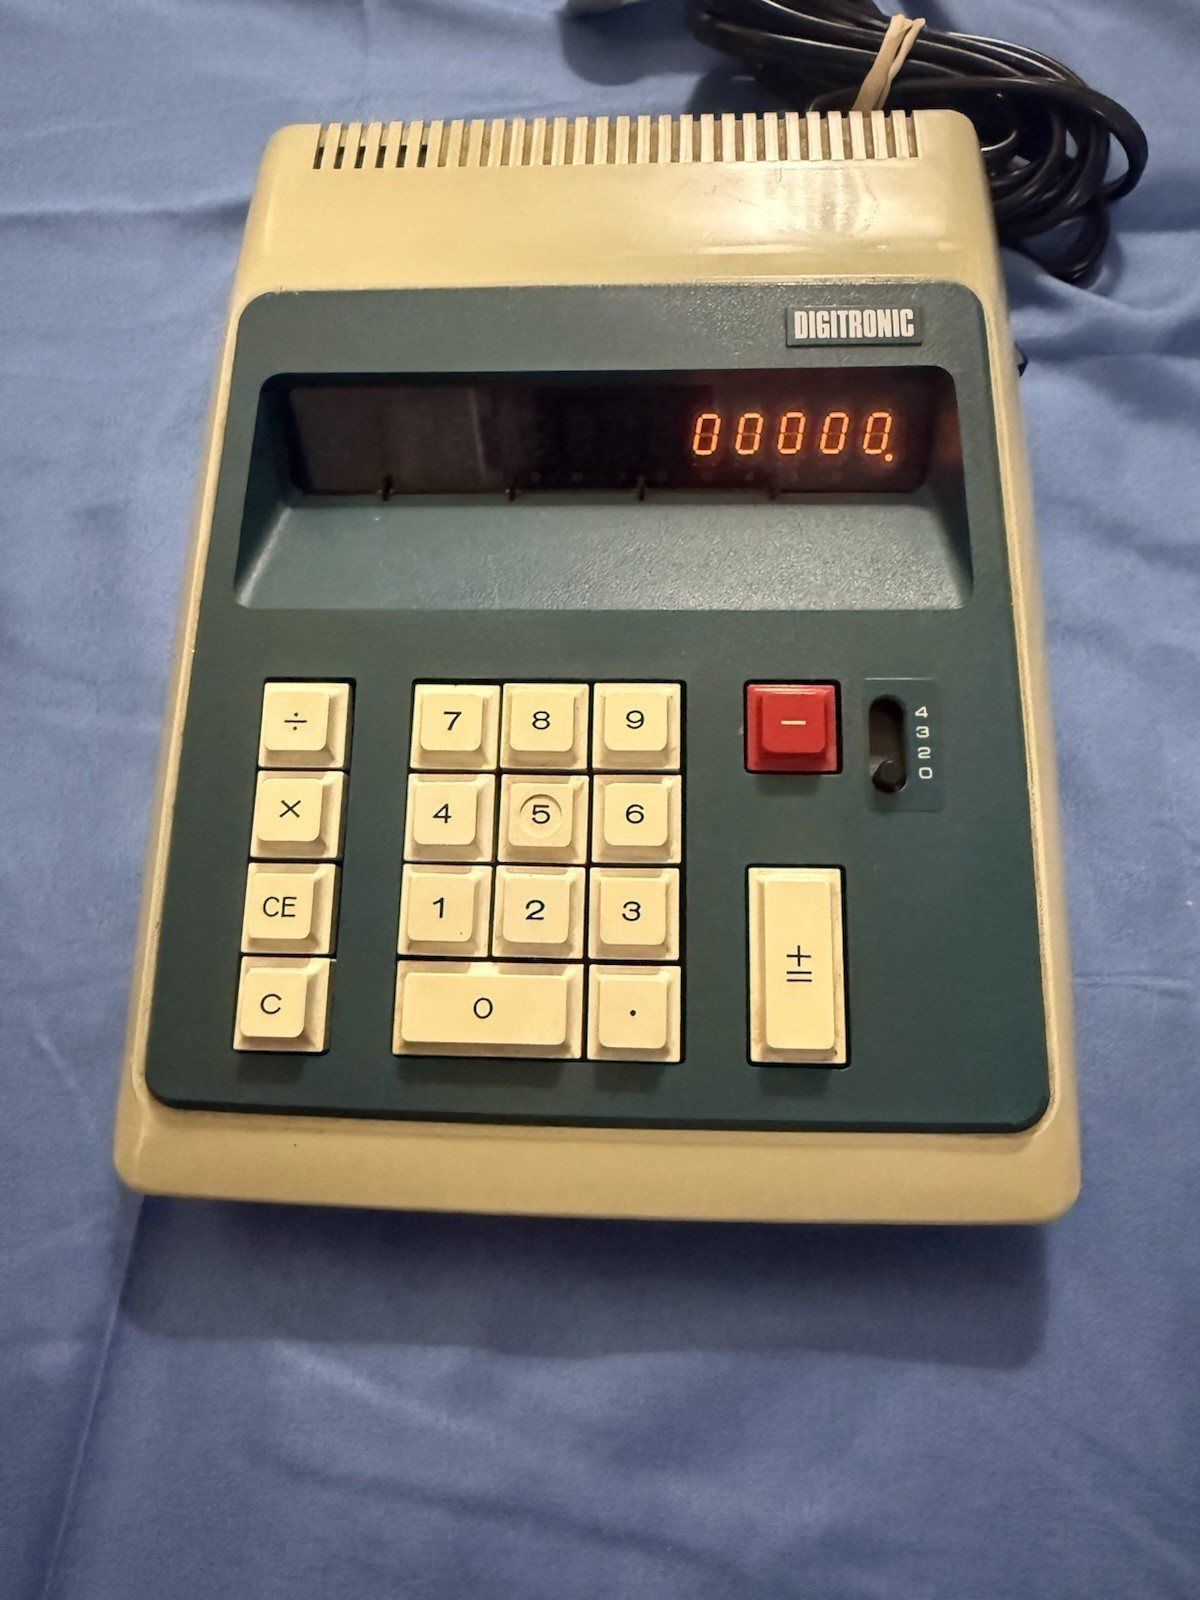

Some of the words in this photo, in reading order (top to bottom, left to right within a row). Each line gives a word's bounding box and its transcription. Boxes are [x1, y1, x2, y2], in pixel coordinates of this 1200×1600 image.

[793, 308, 915, 340] DIGITRONIC
[443, 710, 462, 731] 7
[531, 710, 551, 730] 8
[625, 709, 645, 730] 9
[914, 705, 928, 719] 4
[915, 725, 930, 739] 3
[917, 745, 931, 760] 2
[918, 766, 933, 780] 0
[432, 803, 452, 824] 4
[531, 804, 551, 824] 5
[625, 803, 645, 824] 6
[262, 896, 298, 919] CE
[432, 896, 445, 920] 1
[525, 900, 545, 921] 2
[621, 900, 642, 922] 3
[260, 993, 282, 1015] C
